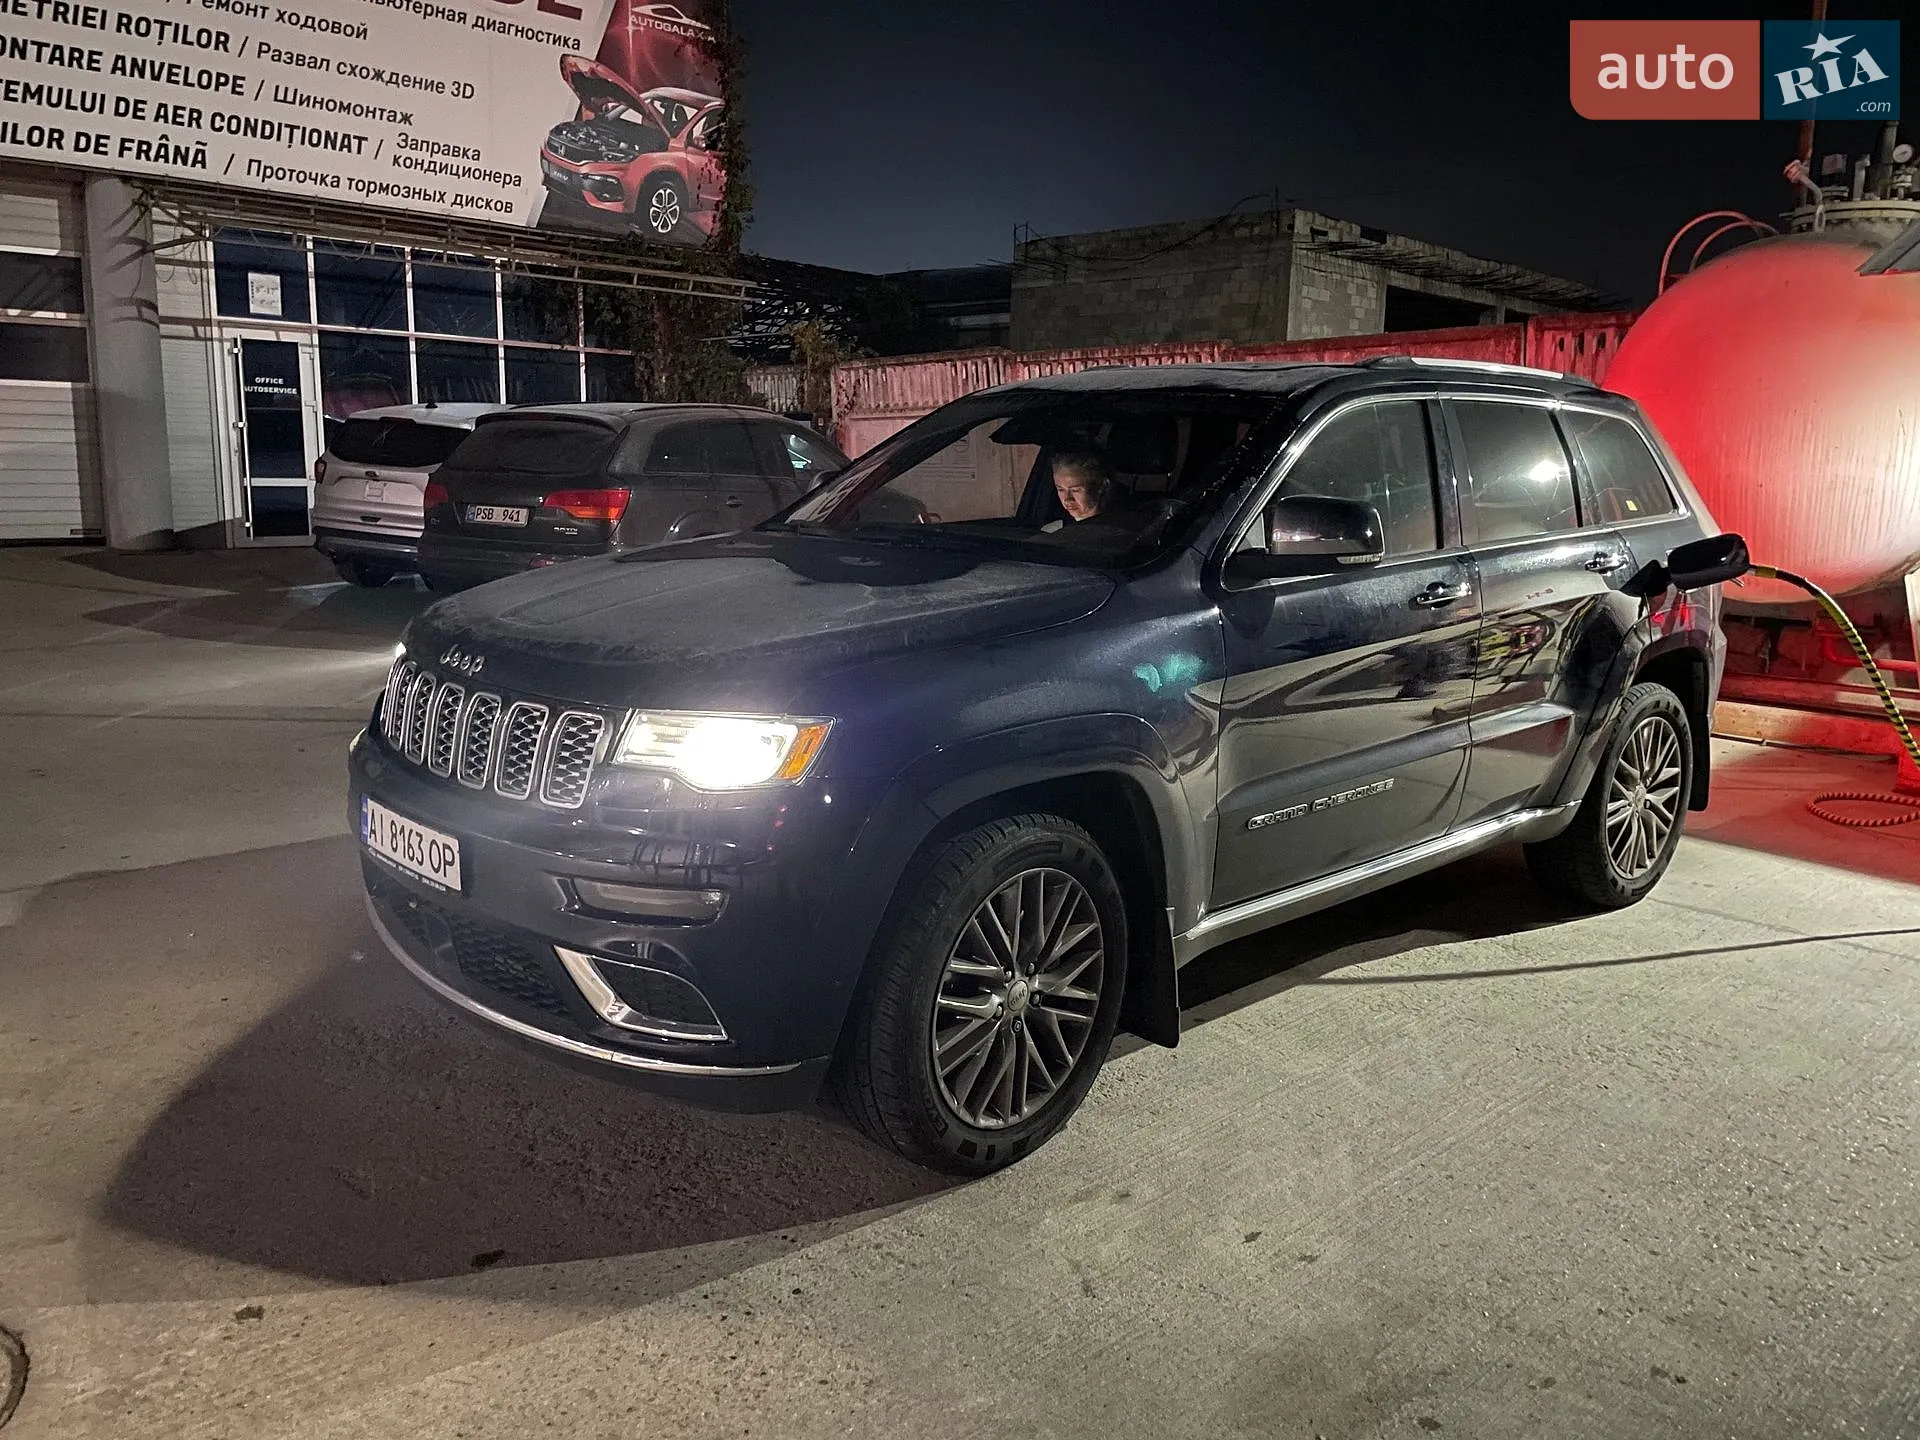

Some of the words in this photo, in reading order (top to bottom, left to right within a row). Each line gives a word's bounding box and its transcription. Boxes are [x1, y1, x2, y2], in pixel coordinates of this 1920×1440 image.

[275, 9, 368, 41] ходовой
[472, 16, 580, 50] диагностика
[116, 13, 230, 53] ROȚILOR
[257, 41, 330, 71] Развал
[337, 62, 446, 94] схождение
[451, 80, 475, 99] 3D
[110, 55, 246, 96] ANVELOPE
[273, 85, 414, 125] Шиномонтаж
[0, 79, 106, 115] EMULUI
[114, 96, 147, 120] DE
[154, 103, 202, 129] AER
[211, 112, 369, 155] CONDIȚIONAT
[397, 132, 481, 161] Заправка
[74, 132, 110, 156] DE
[247, 158, 341, 188] Проточка
[347, 178, 447, 204] тормозных
[451, 194, 513, 213] дисков
[392, 155, 522, 188] кондиционера
[255, 377, 284, 385] OFFICE
[475, 507, 494, 520] PSB
[502, 509, 521, 522] 941
[440, 644, 485, 677] Jeep
[1248, 803, 1308, 830] GRAND
[1311, 777, 1395, 812] CHEROKEE
[369, 809, 384, 847] AI
[390, 820, 425, 867] 8163
[429, 839, 456, 878] OP
